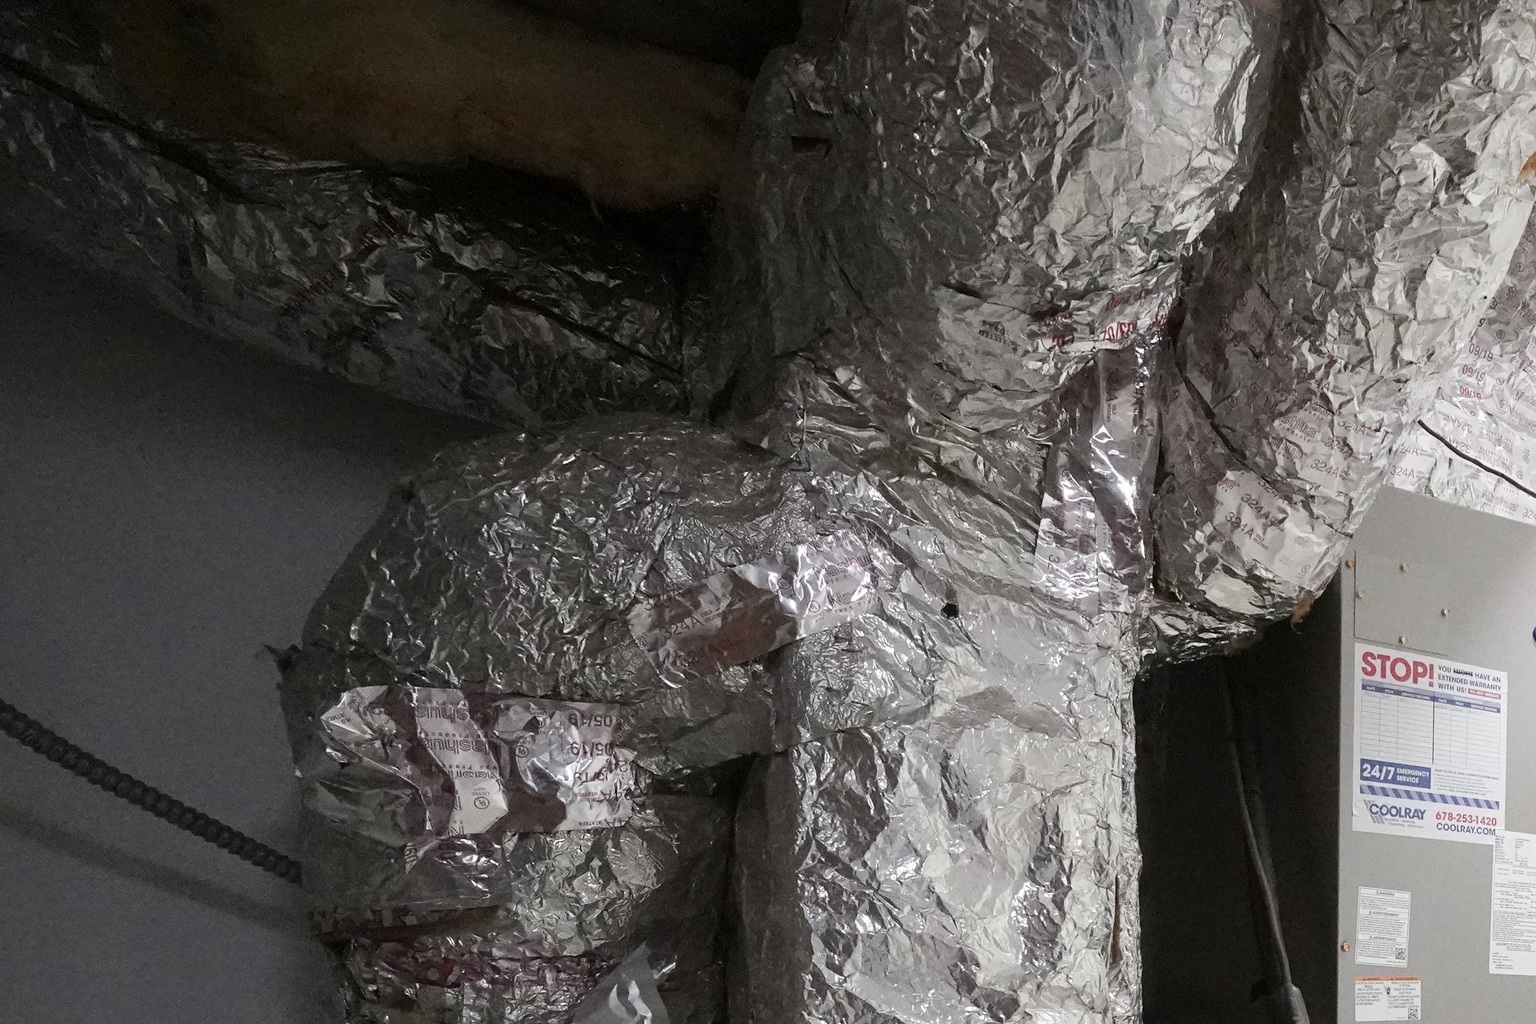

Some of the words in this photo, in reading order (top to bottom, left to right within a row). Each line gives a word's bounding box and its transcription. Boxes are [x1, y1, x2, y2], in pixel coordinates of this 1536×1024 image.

[1468, 342, 1494, 362] 09/19
[1462, 363, 1486, 382] 09/19
[1310, 459, 1340, 478] 324A
[1390, 464, 1416, 479] 324A
[1241, 493, 1271, 521] 324A
[1224, 511, 1255, 538] 324A
[659, 615, 704, 640] 324A
[1361, 651, 1434, 688] STOP!
[1438, 664, 1452, 672] YOU
[1475, 672, 1491, 681] HAVE
[1492, 675, 1501, 683] AN
[1438, 674, 1468, 686] EXTENDED
[1469, 680, 1502, 691] WARRANTY
[1438, 683, 1455, 692] WITH
[1456, 686, 1467, 694] US!
[1362, 763, 1396, 780] 24/7
[1396, 768, 1430, 778] EMERGENCY
[1396, 775, 1420, 784] SERVICE
[1369, 803, 1427, 820] COOLRAY
[1435, 811, 1497, 826] 678-253-1420
[1436, 822, 1497, 836] COOLRAY.COM
